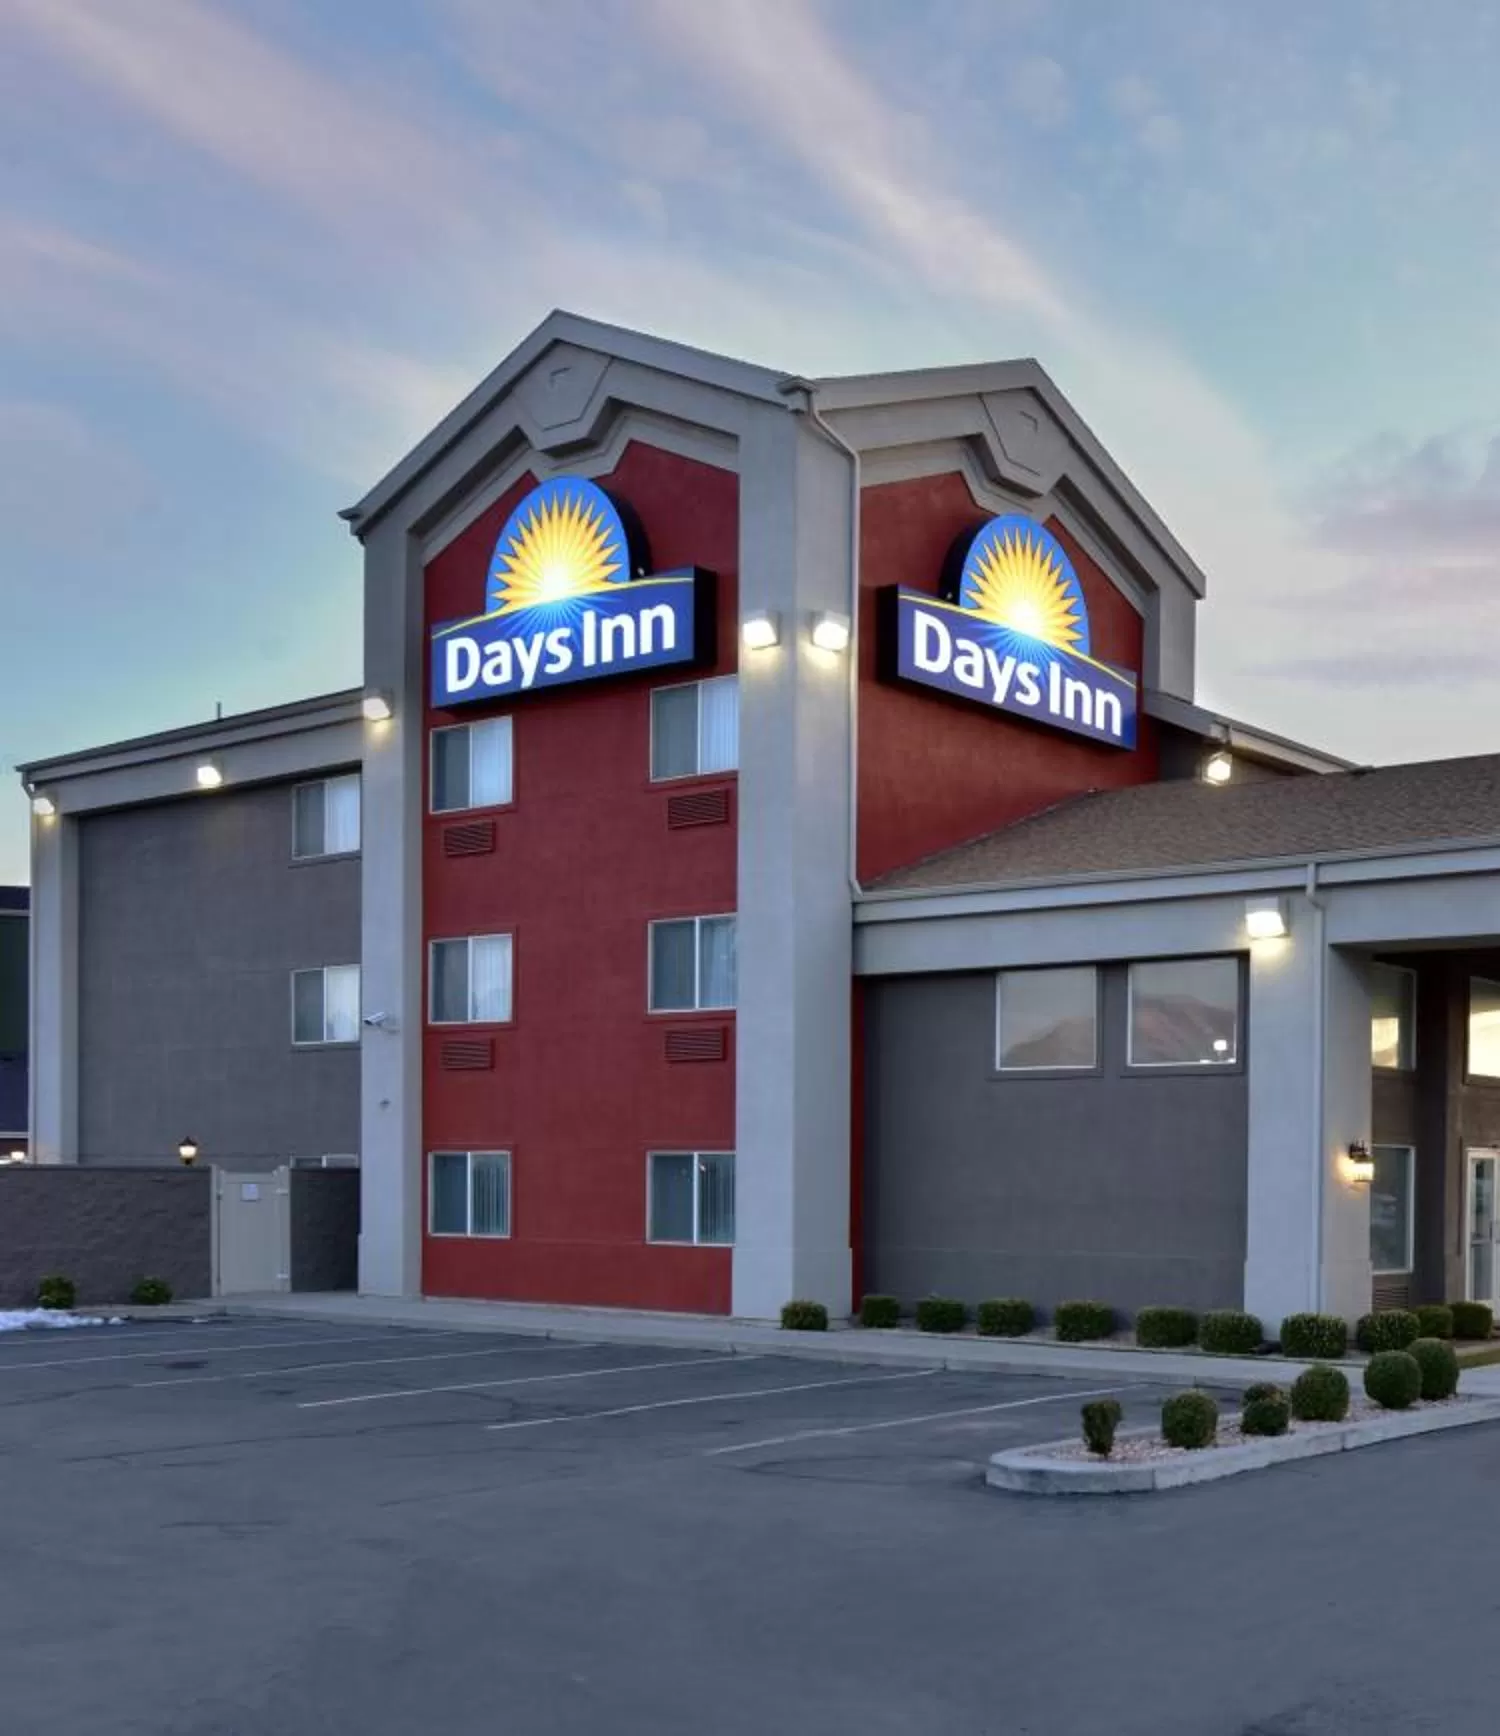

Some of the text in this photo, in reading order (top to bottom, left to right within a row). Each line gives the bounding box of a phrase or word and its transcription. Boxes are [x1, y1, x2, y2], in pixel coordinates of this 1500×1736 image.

[446, 604, 675, 693] Days Inn
[914, 609, 1122, 736] Days Inn
